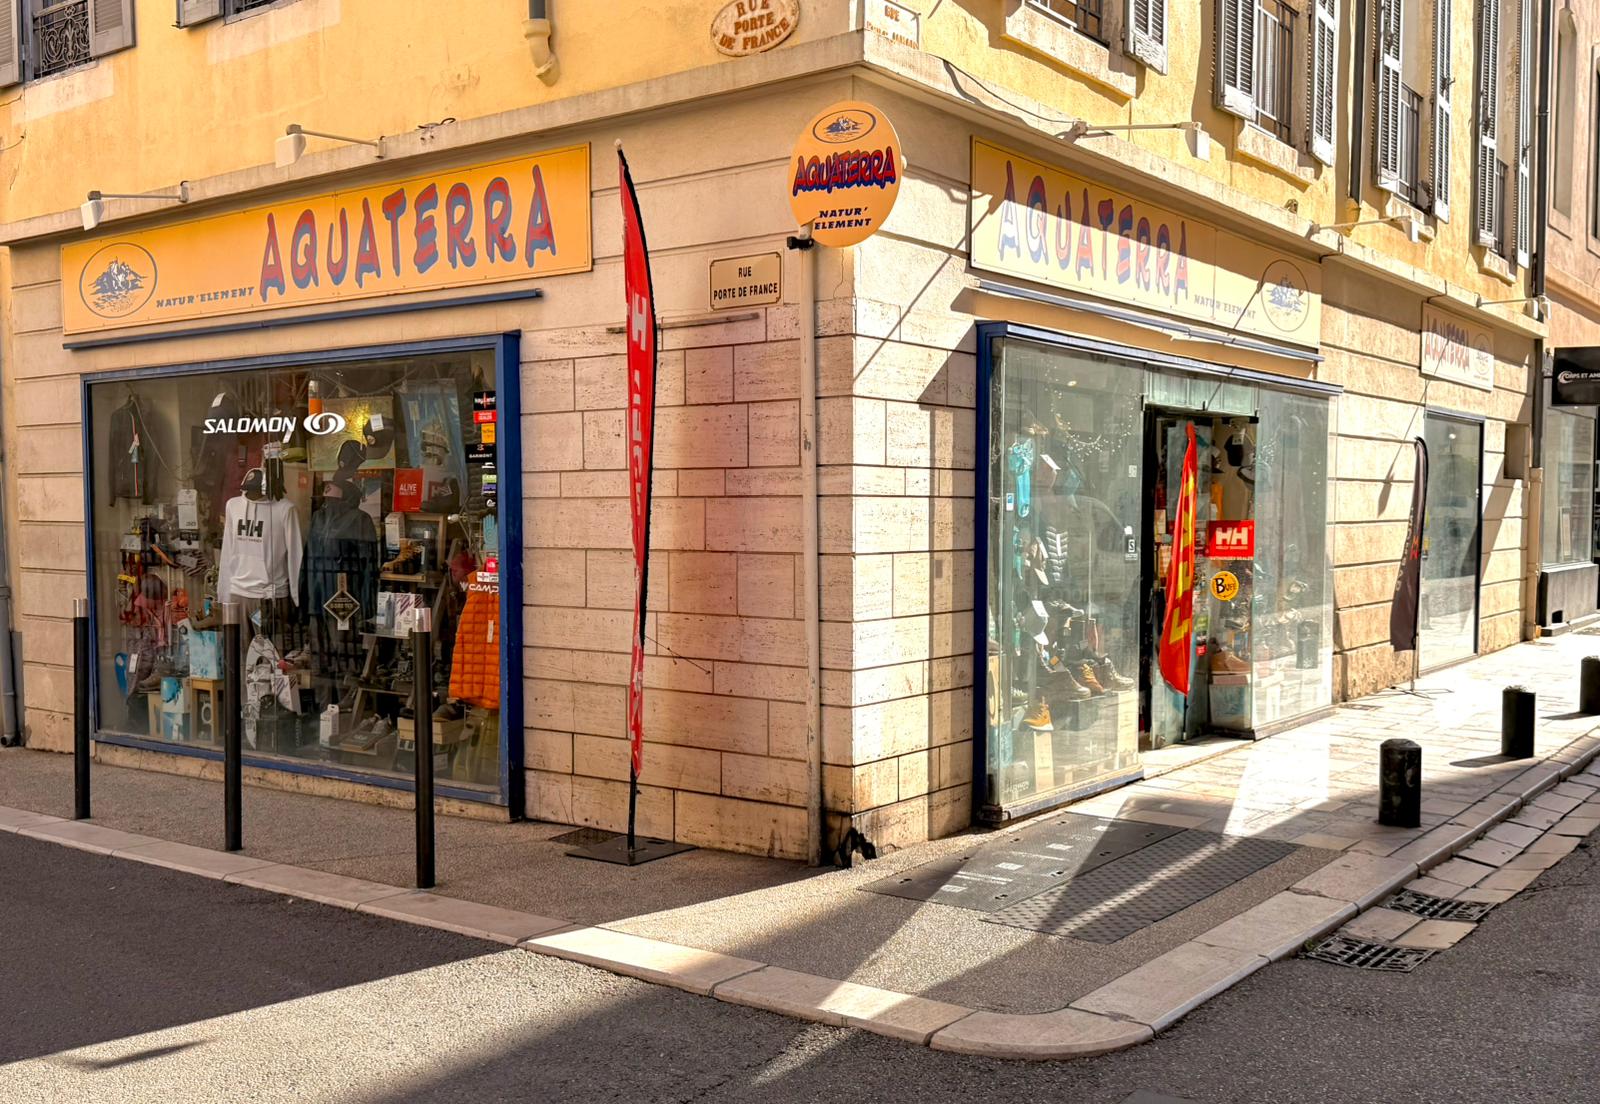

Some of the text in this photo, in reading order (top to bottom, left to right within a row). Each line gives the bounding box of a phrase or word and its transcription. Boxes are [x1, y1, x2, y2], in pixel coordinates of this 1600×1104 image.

[736, 0, 769, 17] RUE
[734, 12, 774, 35] PORTE
[719, 17, 790, 50] DE FRANCE
[792, 146, 896, 197] AQUATERRA
[819, 207, 868, 219] NATUR'
[814, 218, 871, 230] ELEMENT
[998, 160, 1188, 305] AQUATERRA
[259, 164, 556, 303] AQUATERRA
[738, 266, 752, 278] RUE
[713, 282, 778, 301] PORTE DE FRANCE
[203, 416, 297, 434] SALOMON
[237, 519, 264, 538] HH
[1215, 527, 1249, 545] HH
[469, 583, 499, 593] CAMP
